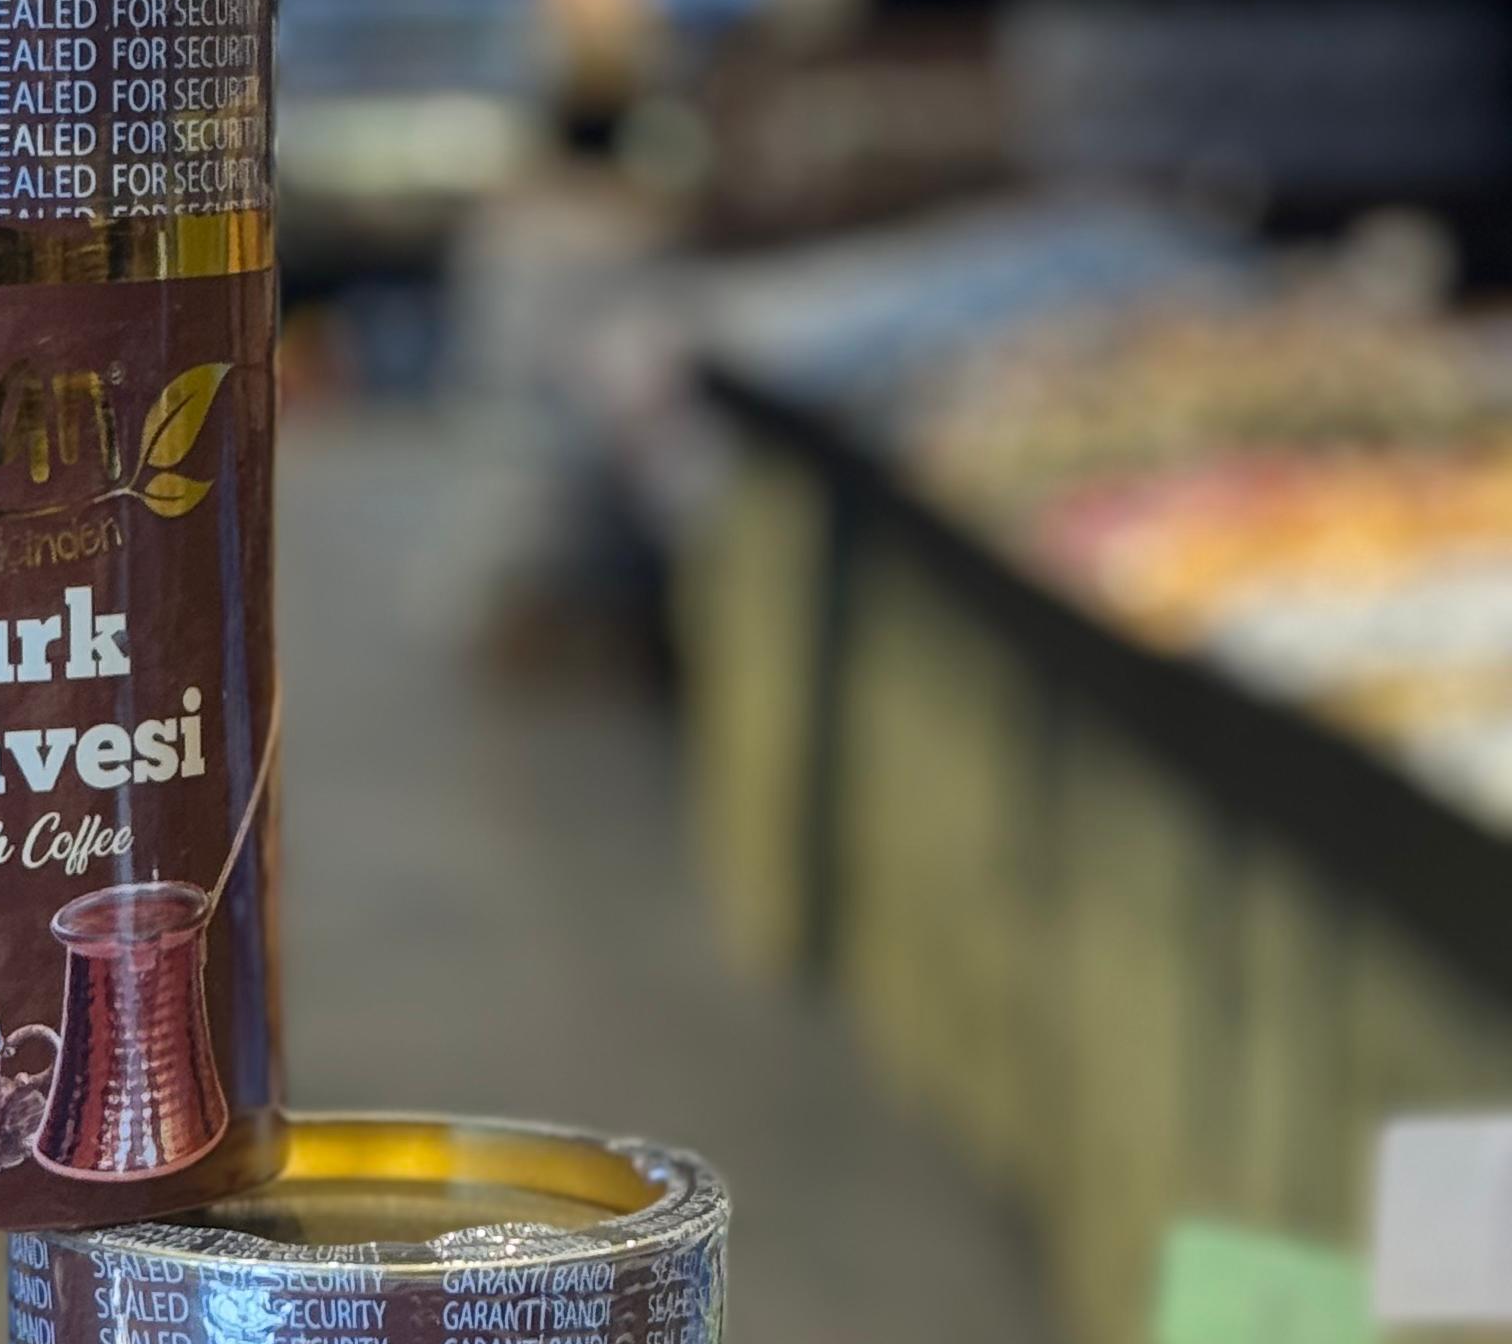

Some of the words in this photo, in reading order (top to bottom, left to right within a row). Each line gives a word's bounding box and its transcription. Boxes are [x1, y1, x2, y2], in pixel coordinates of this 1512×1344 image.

[112, 37, 167, 71] FOR
[112, 79, 167, 113] FOR
[112, 122, 167, 155] FOR
[112, 164, 167, 197] FOR
[22, 811, 134, 876] Coffee
[552, 1263, 616, 1291] BANDI
[553, 1298, 611, 1330] BANDI
